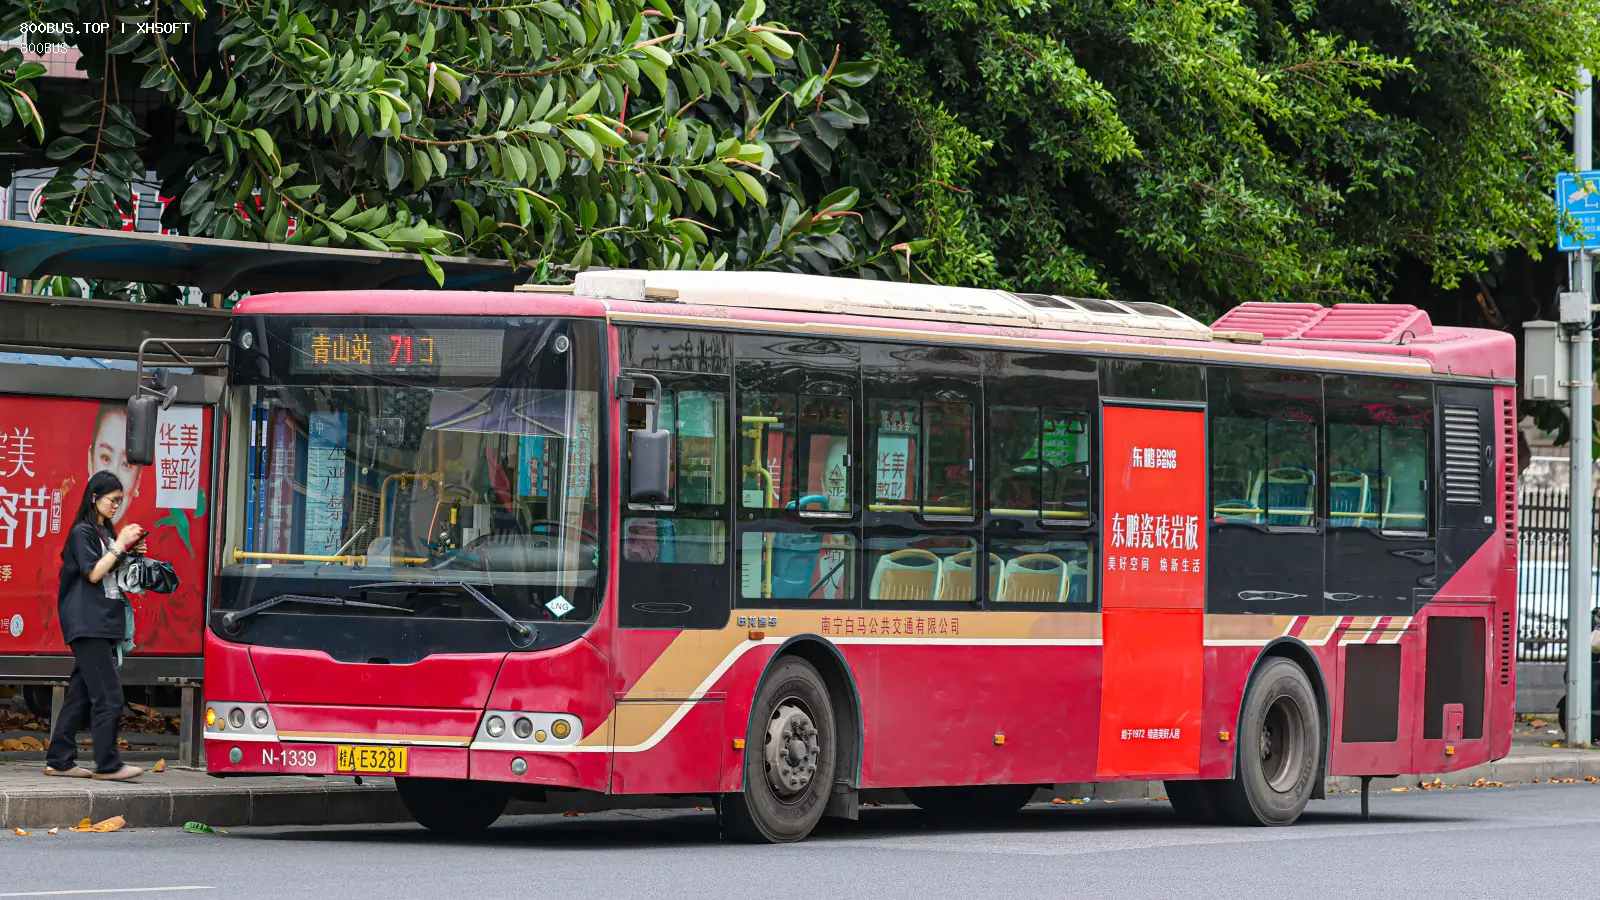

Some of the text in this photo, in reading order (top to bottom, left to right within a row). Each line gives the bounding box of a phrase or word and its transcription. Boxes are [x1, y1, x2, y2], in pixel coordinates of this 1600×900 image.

[311, 333, 372, 364] 青山站
[389, 335, 412, 364] 71
[159, 422, 199, 455] 华美
[1132, 446, 1155, 469] 东鹏
[1156, 448, 1177, 459] DONG
[159, 457, 197, 490] 整形
[1156, 459, 1177, 470] PENG
[1111, 512, 1199, 551] 东鹏瓷砖岩板
[0, 564, 12, 582] 季
[1107, 555, 1201, 573] 美好空间 焕新生活
[550, 602, 569, 611] LNG
[820, 616, 961, 636] 南宁白马公共交通有限公司
[261, 748, 318, 768] N-1339
